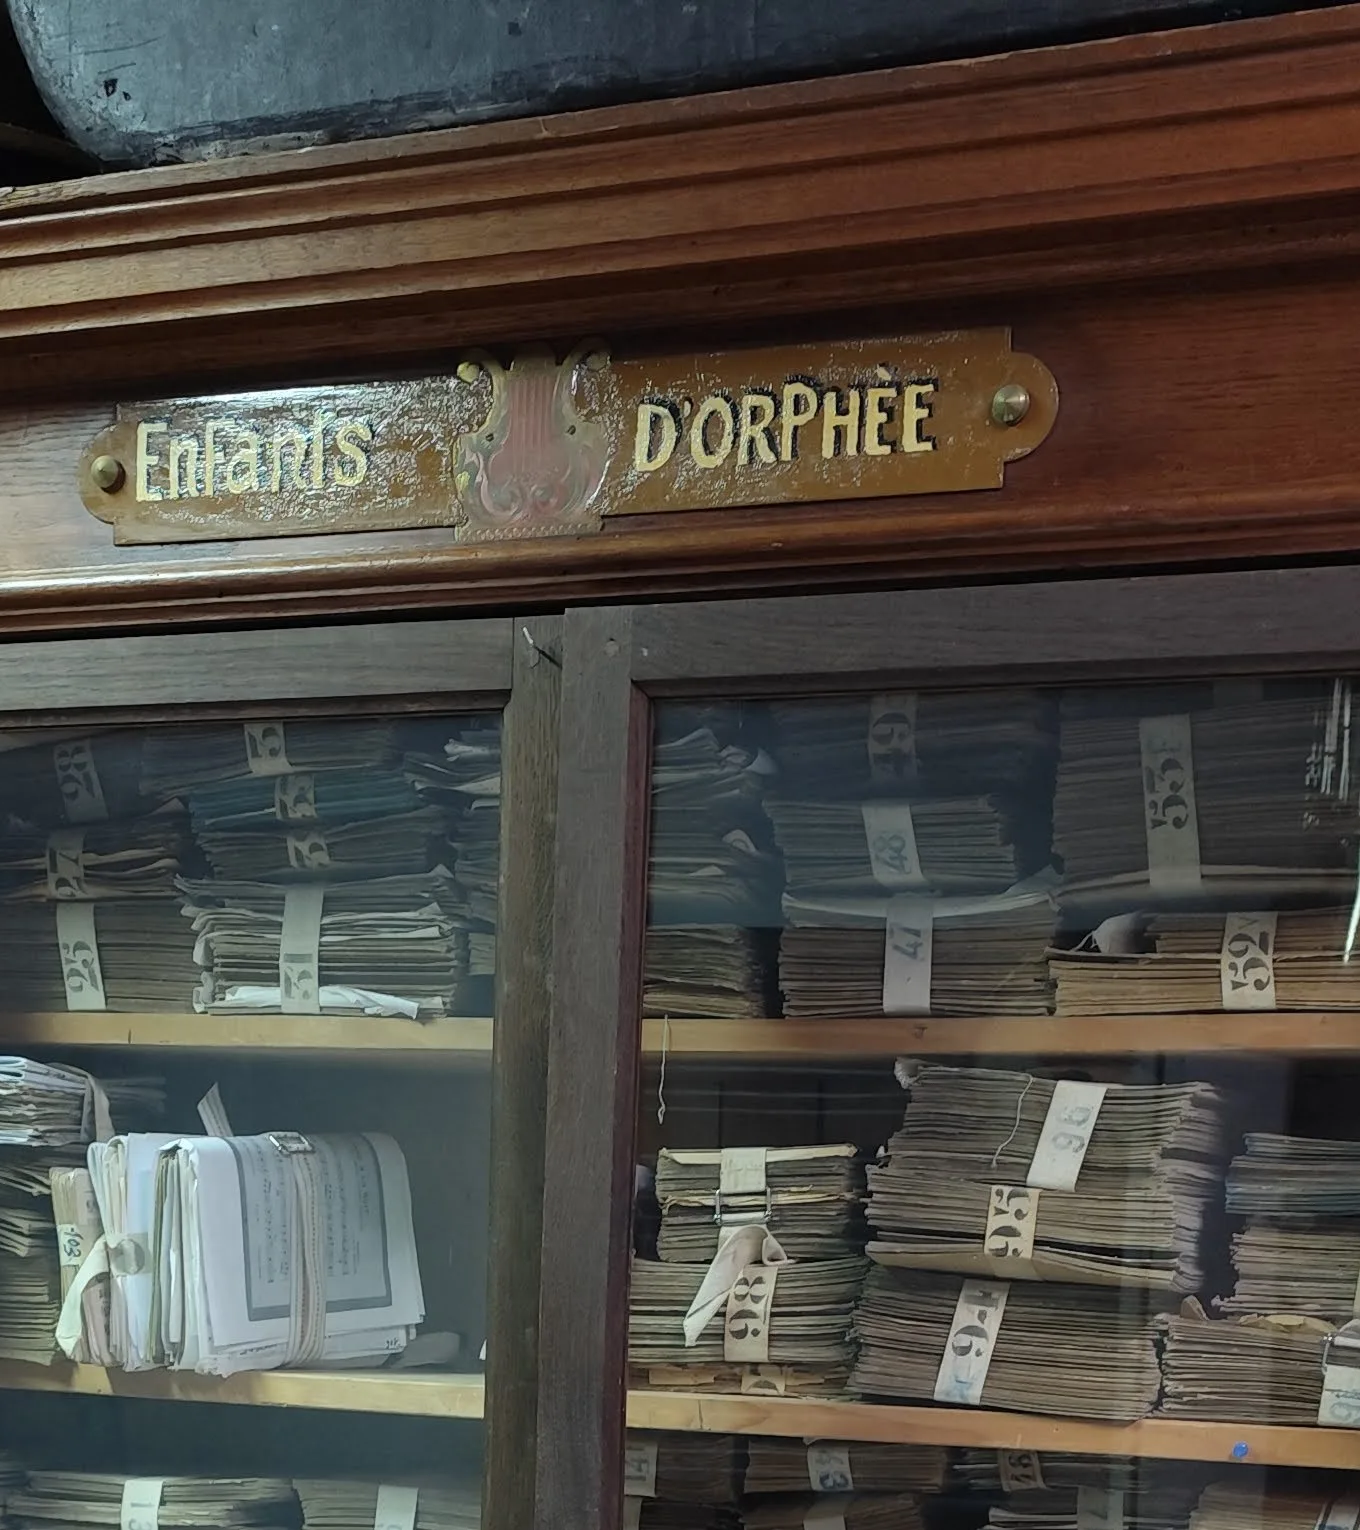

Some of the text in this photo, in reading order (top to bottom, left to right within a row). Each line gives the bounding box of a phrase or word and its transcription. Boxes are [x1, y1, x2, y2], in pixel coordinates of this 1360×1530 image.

[1145, 757, 1189, 830] 53
[1226, 930, 1272, 993] 52
[985, 1186, 1032, 1259] 95
